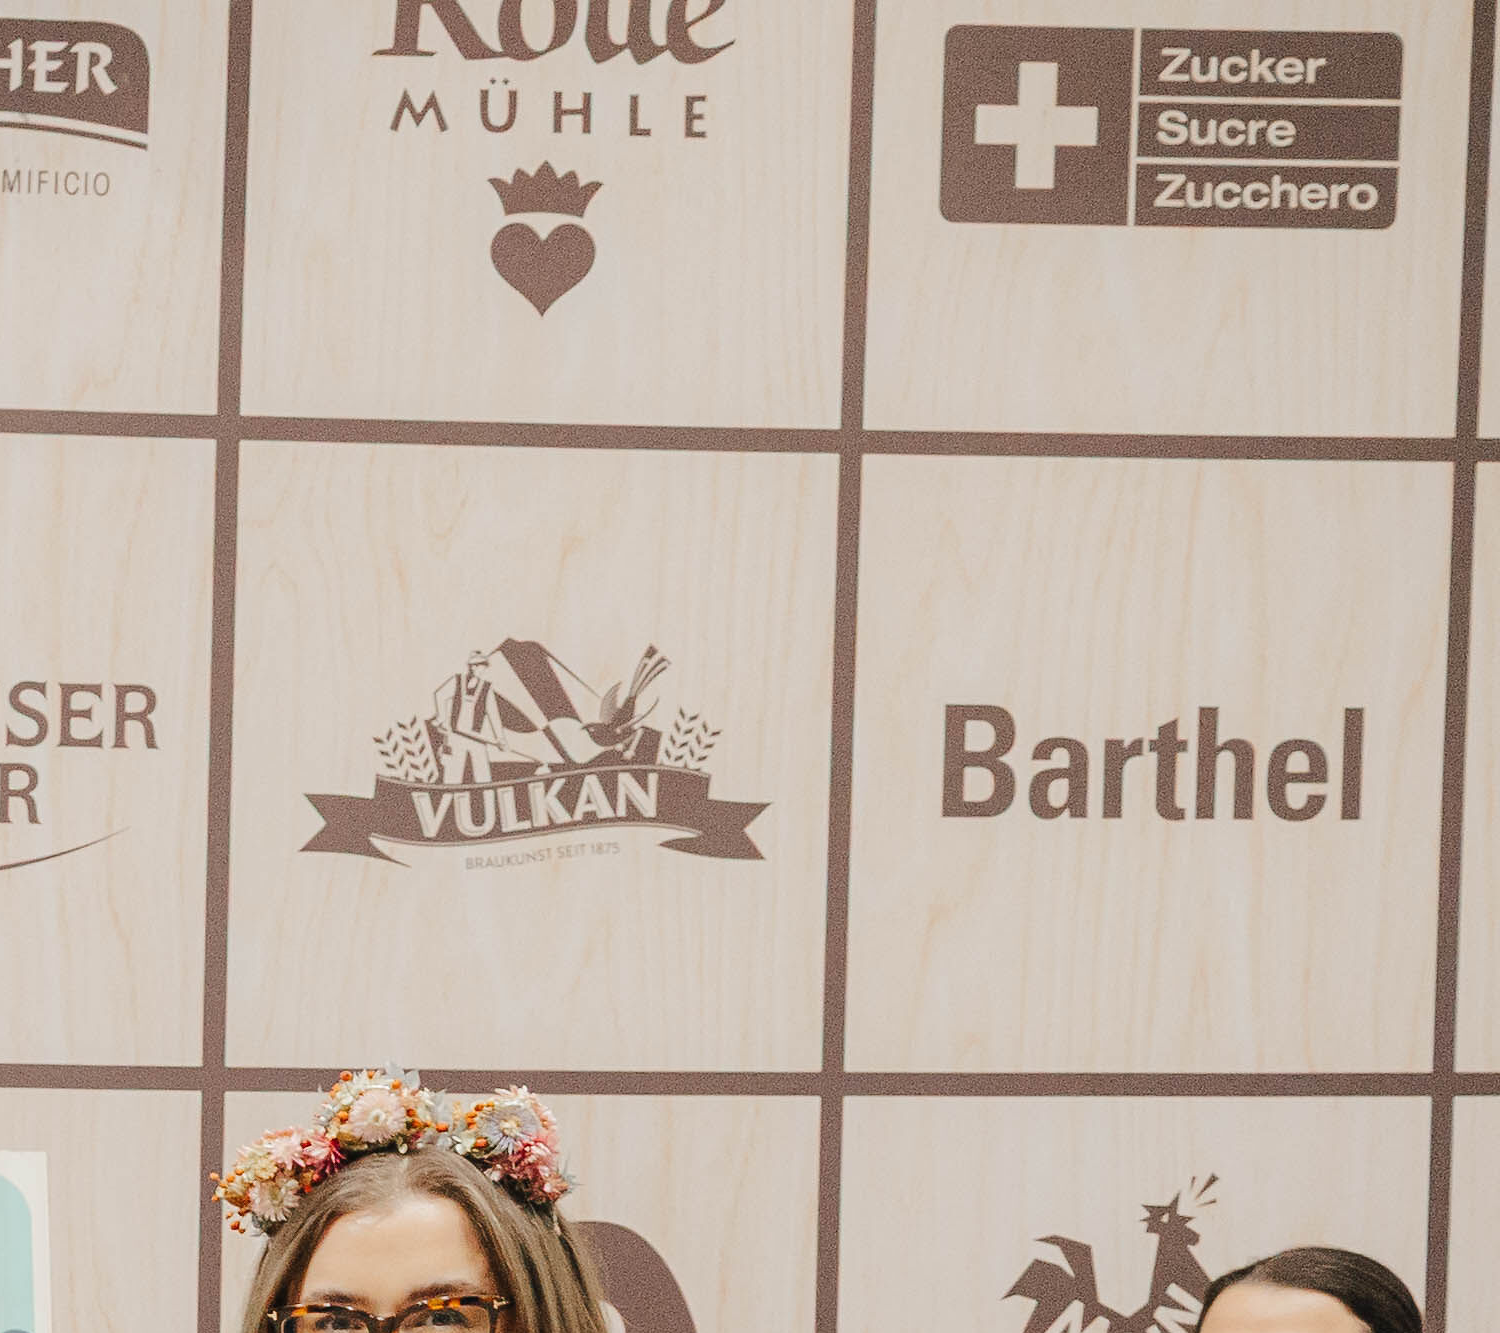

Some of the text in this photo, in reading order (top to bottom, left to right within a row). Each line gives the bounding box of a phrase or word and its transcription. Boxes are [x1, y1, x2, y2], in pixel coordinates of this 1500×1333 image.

[1158, 47, 1327, 84] Zucker
[390, 77, 707, 138] MÜHLE
[1156, 109, 1297, 147] Sucre
[1153, 173, 1379, 211] Zucchero
[940, 704, 1366, 822] Barthel
[411, 771, 659, 838] VULKAN
[465, 841, 621, 871] BRAUKUNST SEIT 1875
